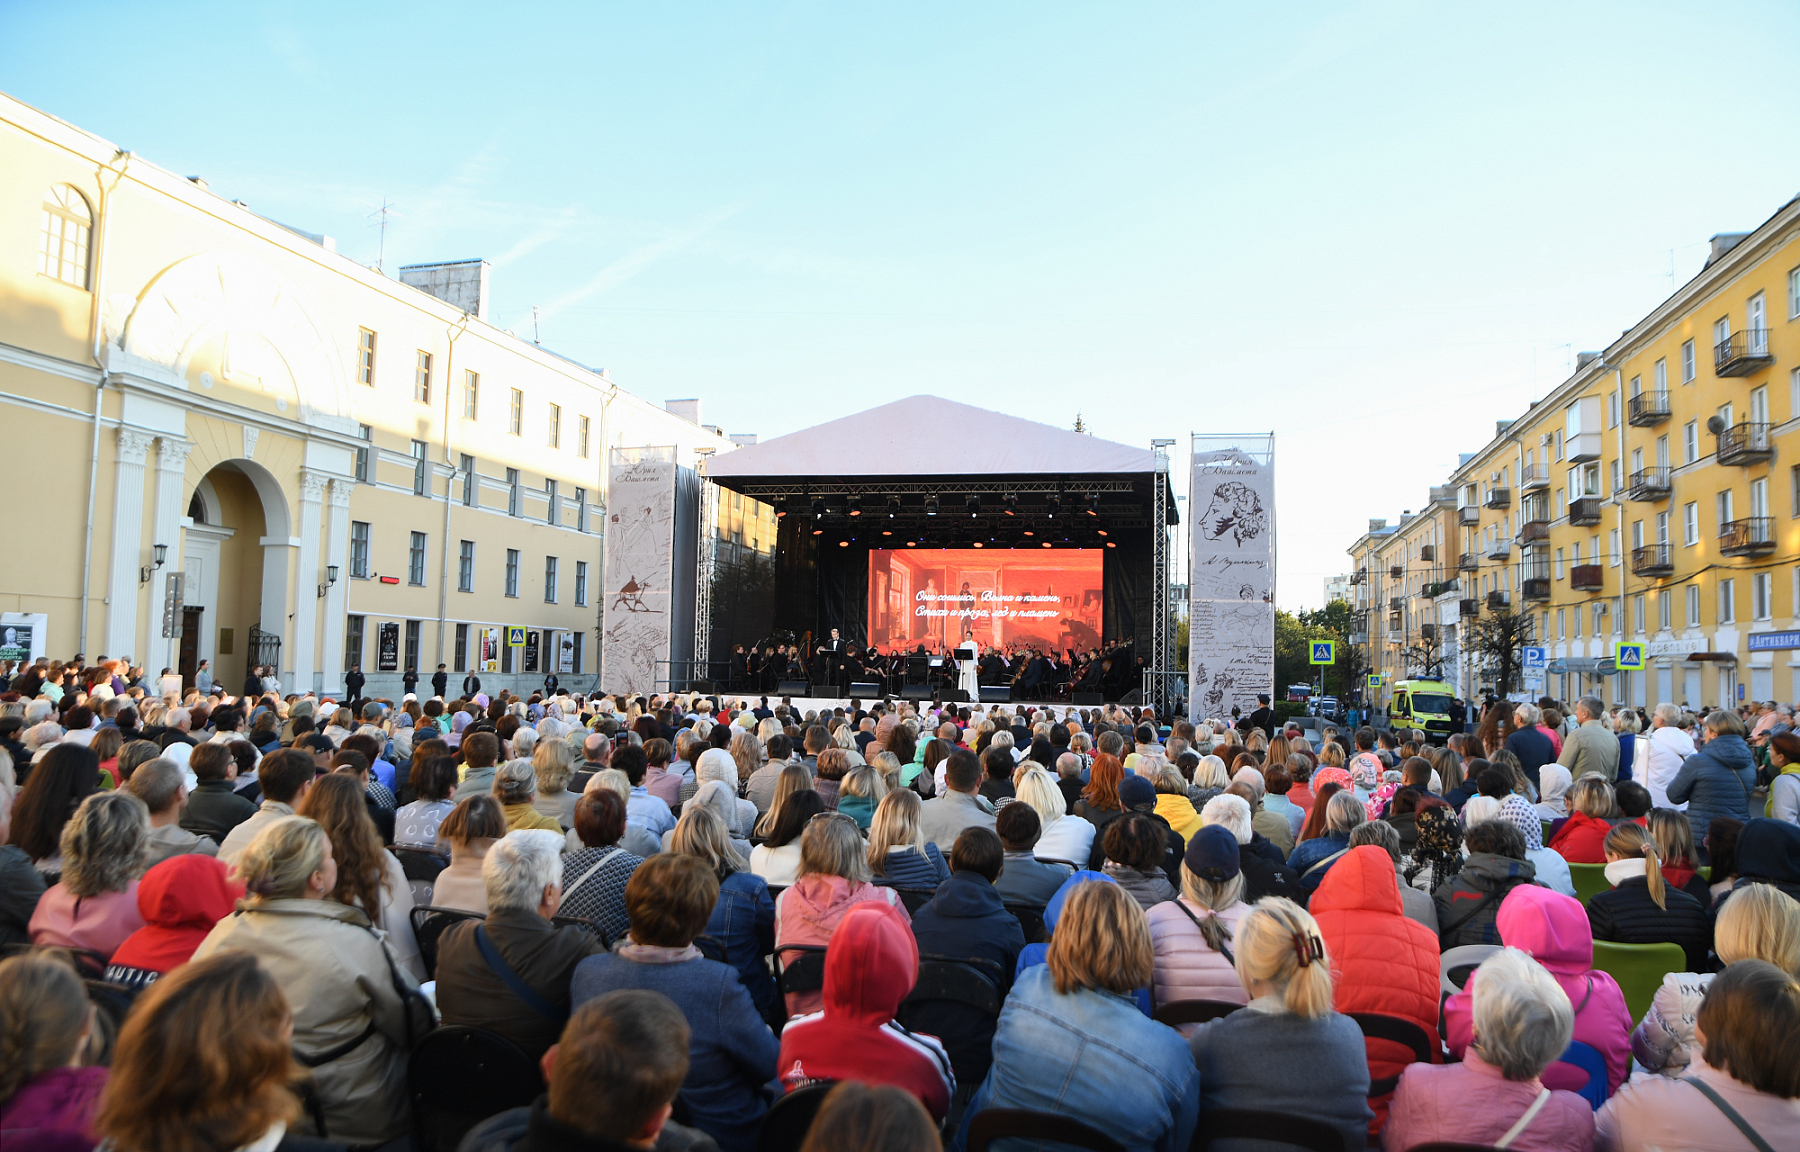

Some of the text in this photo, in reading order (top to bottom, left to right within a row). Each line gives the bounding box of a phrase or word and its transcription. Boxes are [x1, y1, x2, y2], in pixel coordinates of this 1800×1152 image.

[915, 590, 937, 601] Они
[981, 591, 1015, 601] Волна
[1014, 594, 1024, 602] и
[1023, 594, 1061, 603] камень,
[915, 605, 950, 617] Стихи
[957, 607, 990, 620] проза,
[991, 606, 1009, 617] лед
